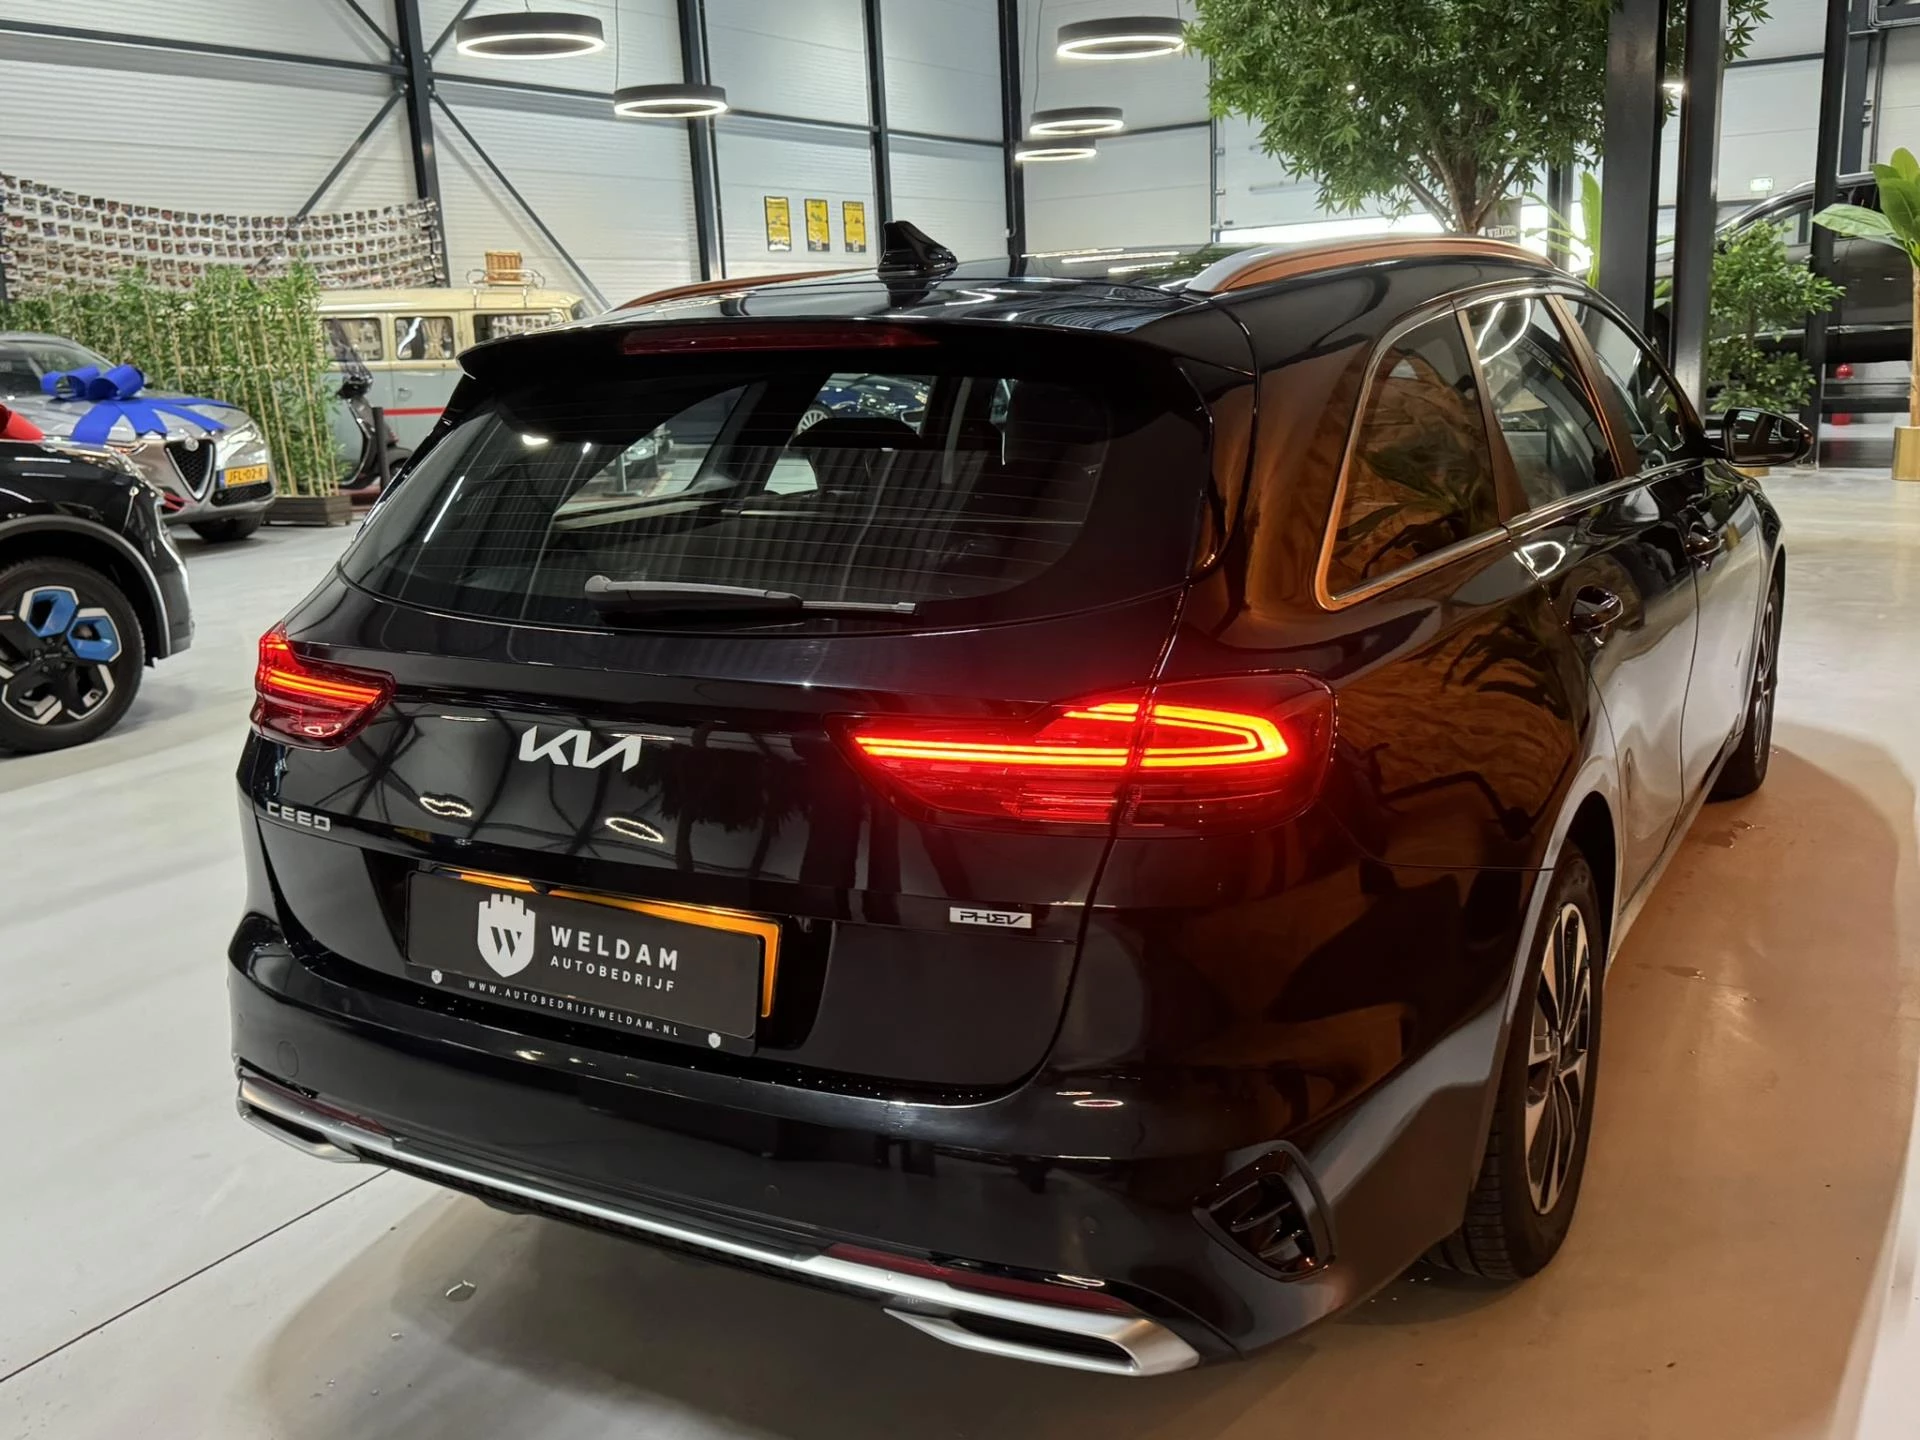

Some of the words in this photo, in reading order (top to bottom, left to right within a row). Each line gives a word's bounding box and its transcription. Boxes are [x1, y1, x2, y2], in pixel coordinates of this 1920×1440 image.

[518, 725, 642, 772] KIA
[267, 801, 331, 832] CEED
[960, 911, 1024, 925] PHEV
[551, 925, 678, 971] WELDAM
[550, 955, 674, 992] AUTOBEDRIJF
[468, 980, 679, 1036] WWW.AUTOBEDRIJFWELDAM.NL
